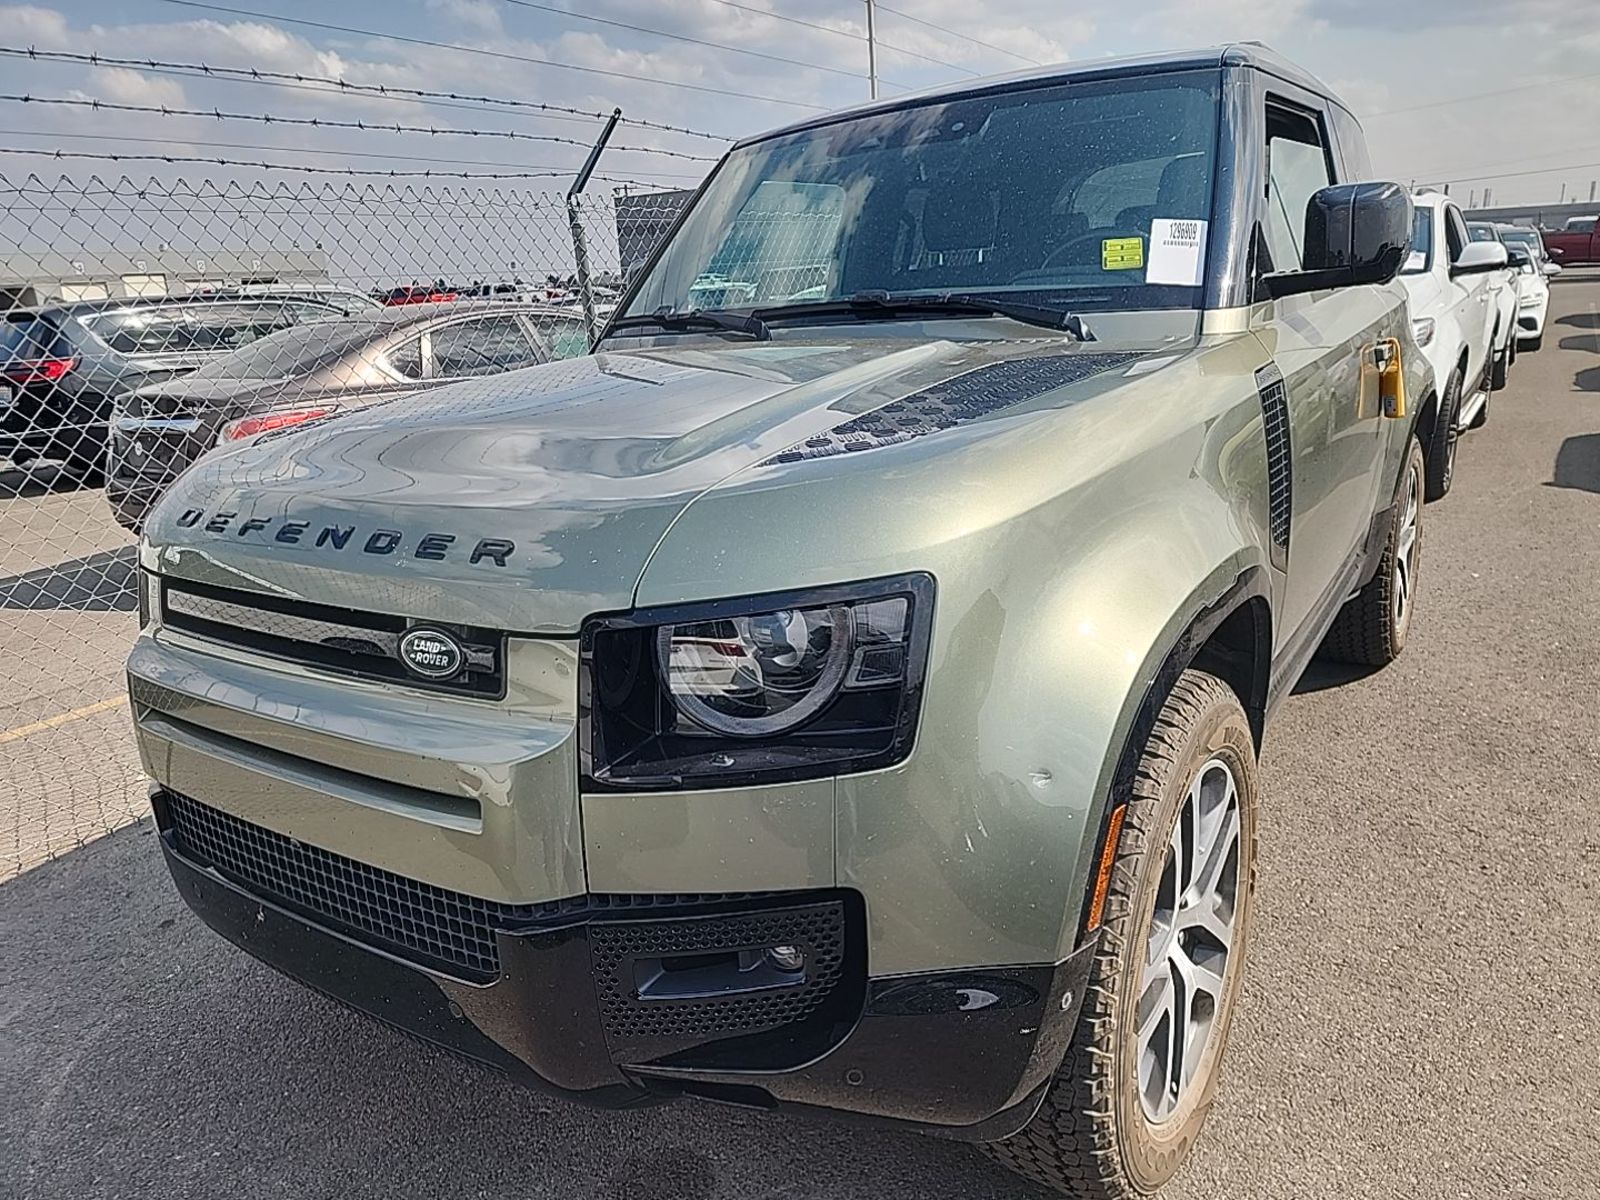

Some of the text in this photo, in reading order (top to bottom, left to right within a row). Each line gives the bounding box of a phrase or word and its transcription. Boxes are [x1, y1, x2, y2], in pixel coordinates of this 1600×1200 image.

[1170, 222, 1198, 240] 1296909
[176, 507, 516, 568] DEFENDER
[413, 639, 441, 653] LAND
[415, 652, 449, 667] ROVER
